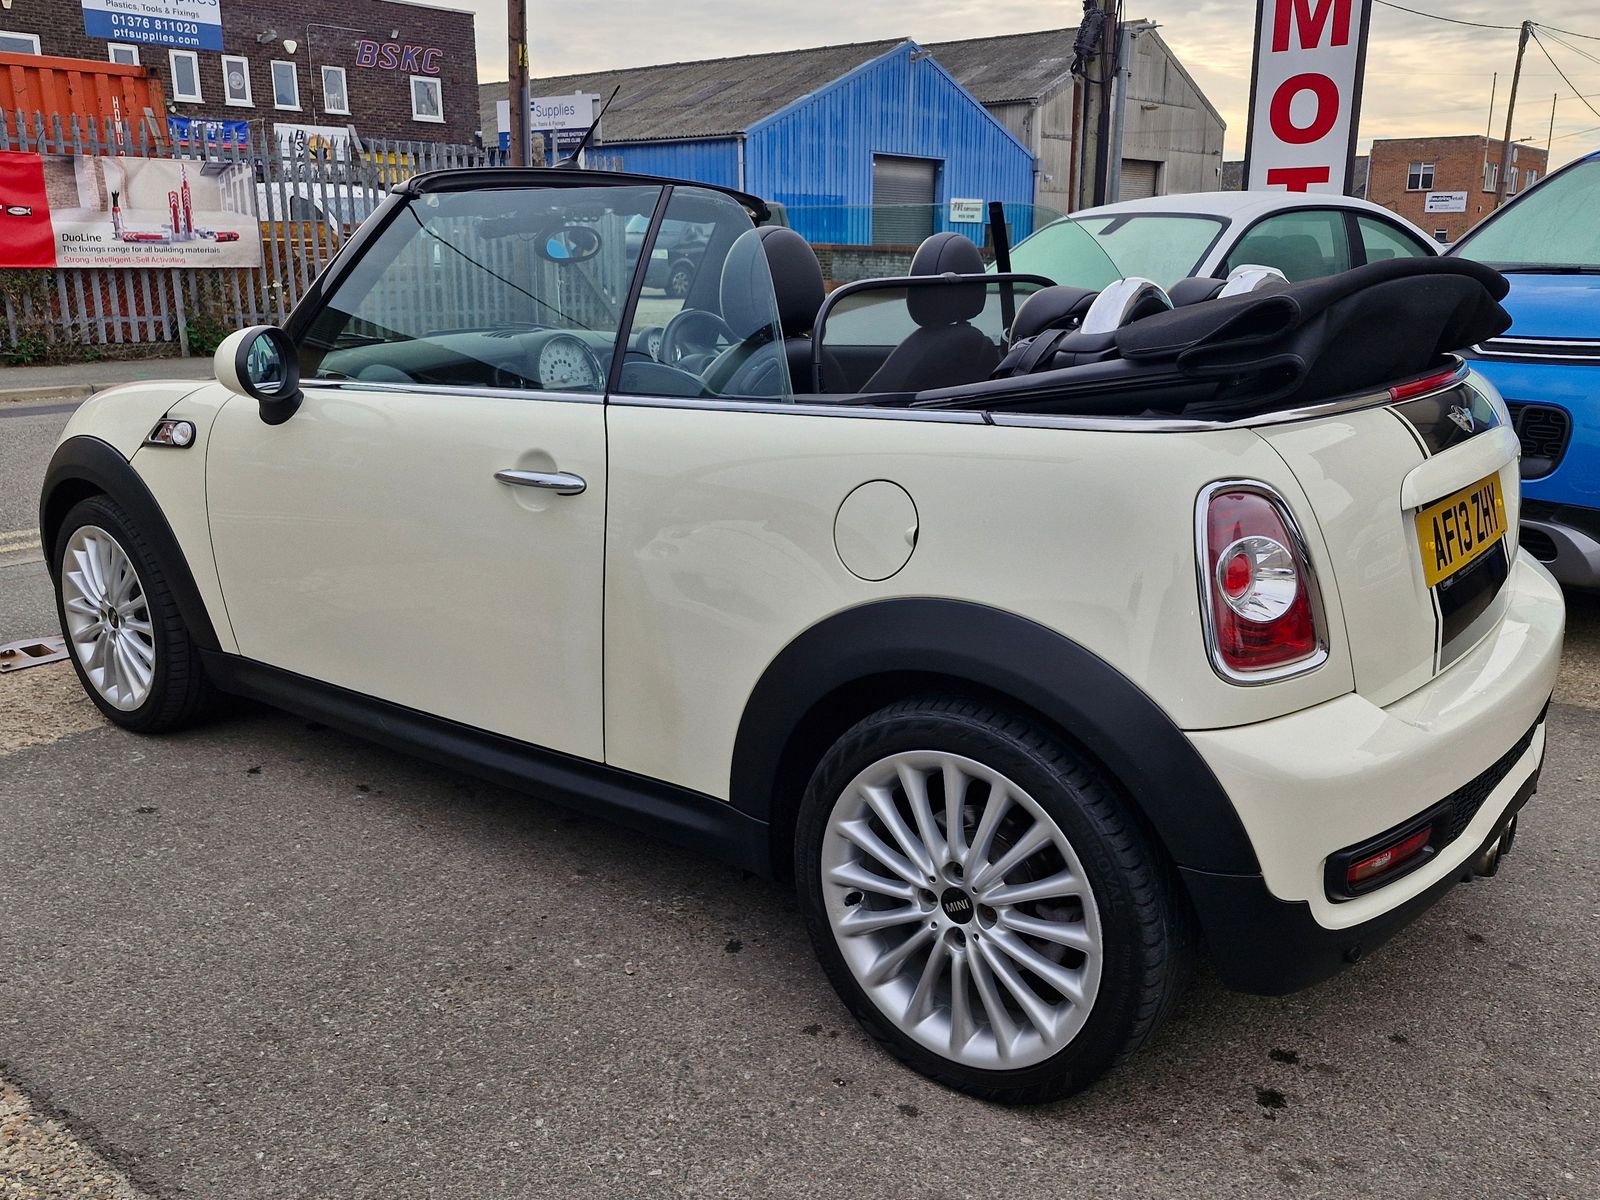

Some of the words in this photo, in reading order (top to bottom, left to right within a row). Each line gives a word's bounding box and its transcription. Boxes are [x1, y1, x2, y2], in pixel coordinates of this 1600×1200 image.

[141, 4, 163, 14] Tools
[173, 8, 200, 19] Fixings
[111, 14, 150, 28] 01376
[154, 19, 198, 34] 811020
[113, 28, 200, 45] ptfsupplies.com
[356, 39, 443, 74] BSKC
[536, 104, 575, 119] Supplies
[62, 233, 102, 242] DuoLine
[78, 245, 106, 254] fixings
[107, 247, 131, 255] range
[153, 246, 184, 255] building
[1432, 500, 1473, 572] AF13
[1471, 482, 1498, 543] ZHY
[945, 899, 970, 913] MINI
